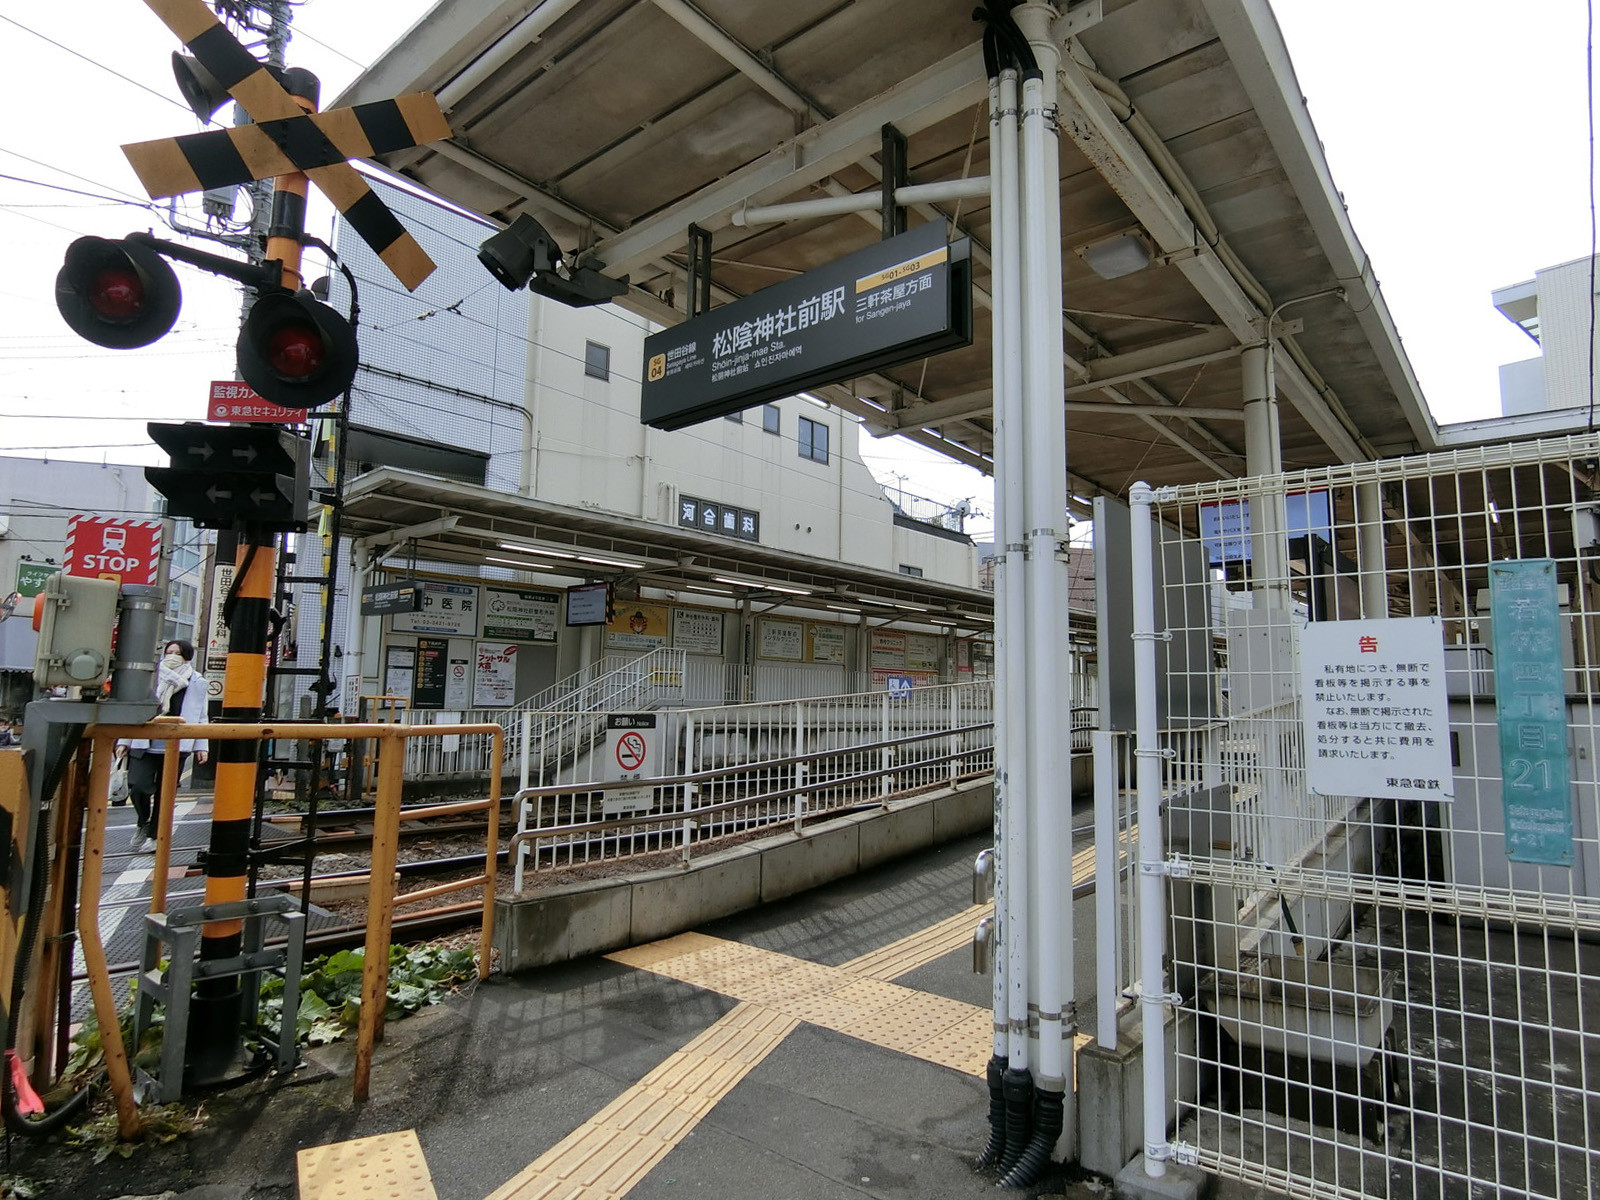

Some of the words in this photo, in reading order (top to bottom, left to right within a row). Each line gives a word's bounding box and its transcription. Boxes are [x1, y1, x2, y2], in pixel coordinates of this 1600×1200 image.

[855, 273, 933, 313] 三軒茶屋方面
[855, 314, 865, 324] for
[866, 299, 912, 321] Sangen-jaya
[711, 285, 846, 361] 松陰神社前駅
[651, 366, 662, 378] 04
[213, 385, 263, 399] 監視カメ
[230, 406, 303, 418] 東急セキュリティ
[682, 502, 755, 534] 河合歯科
[82, 554, 140, 572] STOP
[215, 568, 233, 639] 世田谷整形外科
[1358, 636, 1378, 653] 告
[1324, 663, 1430, 674] 私有地につき、無断で
[1314, 678, 1431, 688] 看板等を掲示する事を
[1315, 692, 1392, 702] 禁止いたします。
[1326, 706, 1433, 717] なお、無断で掲示された
[1317, 721, 1432, 731] 看板等は当方にて撤去、
[1317, 734, 1435, 746] 処分すると共に費用を
[1318, 748, 1395, 760] 請求いたします。
[1509, 758, 1551, 790] 21
[1386, 777, 1441, 790] 東急電鉄
[1510, 833, 1545, 847] 4-21
